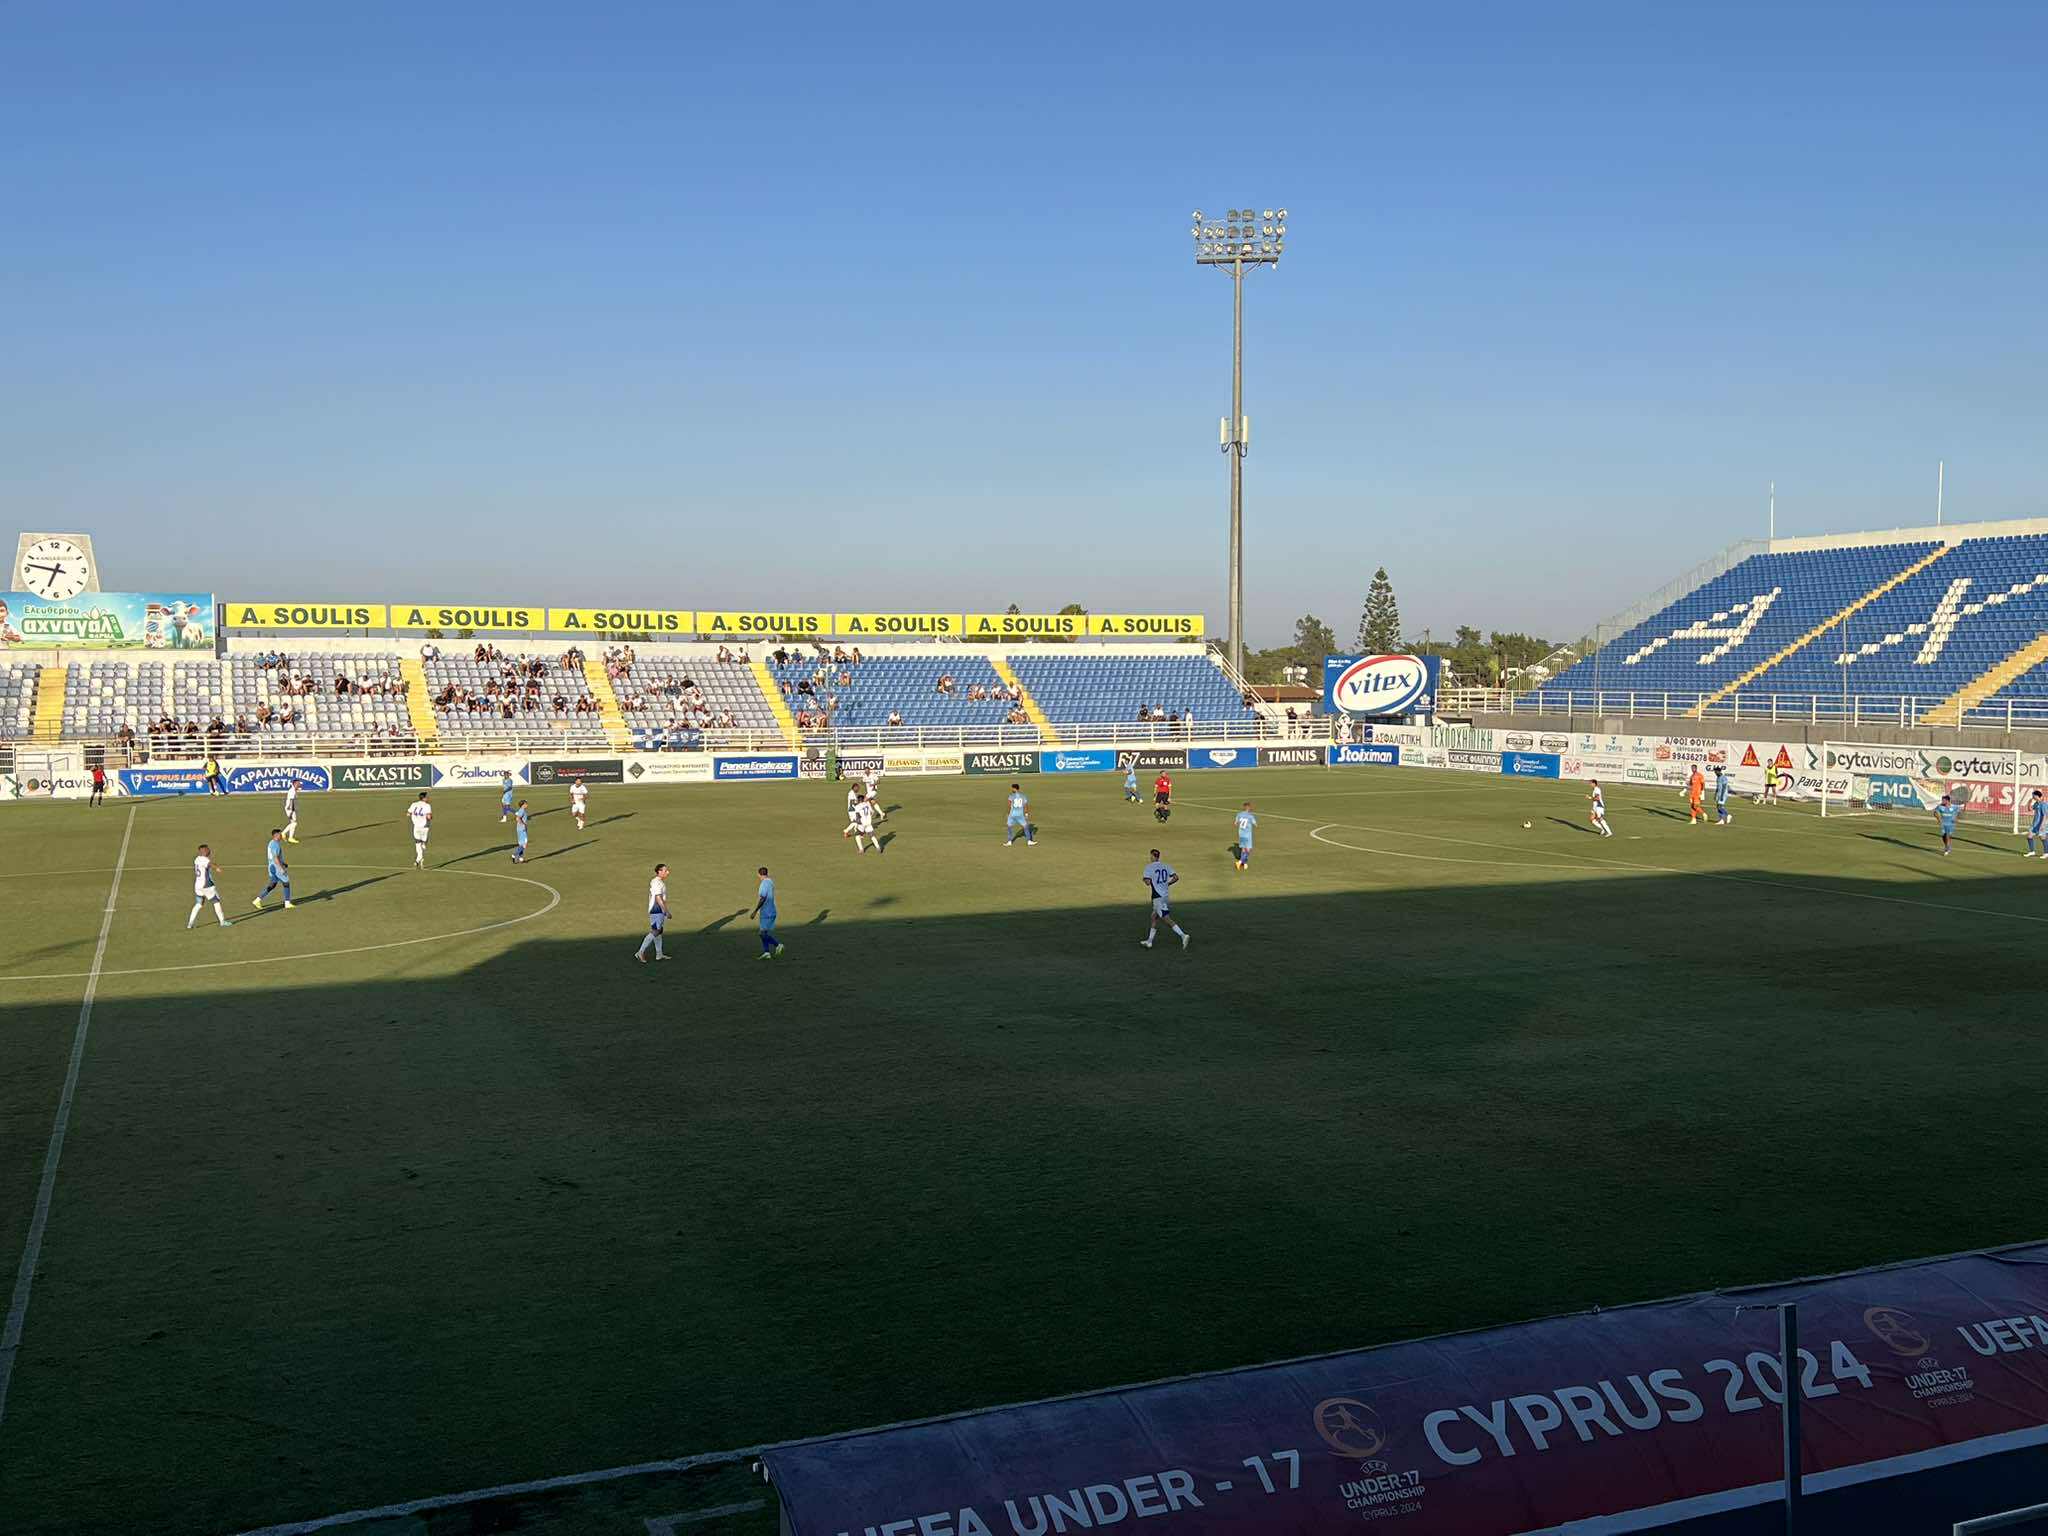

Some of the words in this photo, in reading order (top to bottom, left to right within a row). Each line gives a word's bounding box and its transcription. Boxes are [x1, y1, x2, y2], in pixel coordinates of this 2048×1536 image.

[240, 607, 266, 624] A.
[274, 607, 370, 625] SOULIS
[407, 608, 431, 625] A.
[438, 609, 529, 627] SOULIS
[564, 612, 587, 629] A.
[593, 612, 679, 630] SOULIS
[711, 615, 732, 631] A.
[738, 615, 818, 632] SOULIS
[849, 617, 869, 632] A.
[874, 617, 950, 632] SOULIS
[978, 618, 997, 633] A.
[1002, 618, 1074, 633] SOULIS
[1101, 619, 1119, 633] A.
[1124, 618, 1192, 633] SOULIS
[1348, 672, 1411, 695] vitex
[971, 753, 1032, 768] ARKASTIS
[1140, 757, 1157, 765] CAR
[1159, 757, 1184, 765] SALES
[1268, 750, 1317, 762] TIMINIS
[1337, 746, 1392, 762] Stoiximan
[1837, 752, 1914, 770] cytavision
[343, 766, 422, 782] ARKASTIS
[720, 761, 750, 771] Panos
[802, 762, 826, 771] ΚΙΚΗ
[1953, 757, 2039, 777] cytavison
[230, 768, 327, 789] ΧΑΡΑΛΑΜΠΙΔΗΣ
[254, 779, 303, 791] ΚΡΙΣΤΗ
[1797, 776, 1849, 790] Panaech
[1155, 869, 1168, 884] 20
[1956, 1315, 2048, 1356] UEFA
[1904, 1366, 1968, 1389] UNDER-17
[1912, 1380, 1974, 1399] CHAMPIONSHIP
[1423, 1369, 1704, 1466] CYPRUS
[1703, 1340, 1874, 1413] 2024
[1360, 1459, 1391, 1474] UEFA
[837, 1507, 993, 1536] FA
[1003, 1469, 1205, 1536] UNDER
[1242, 1448, 1299, 1494] 17
[1339, 1470, 1421, 1498] UNDER-17
[1347, 1486, 1426, 1509] CHAMPIONSHIP
[1362, 1506, 1399, 1521] CYPRUS
[1400, 1502, 1422, 1513] 2024
